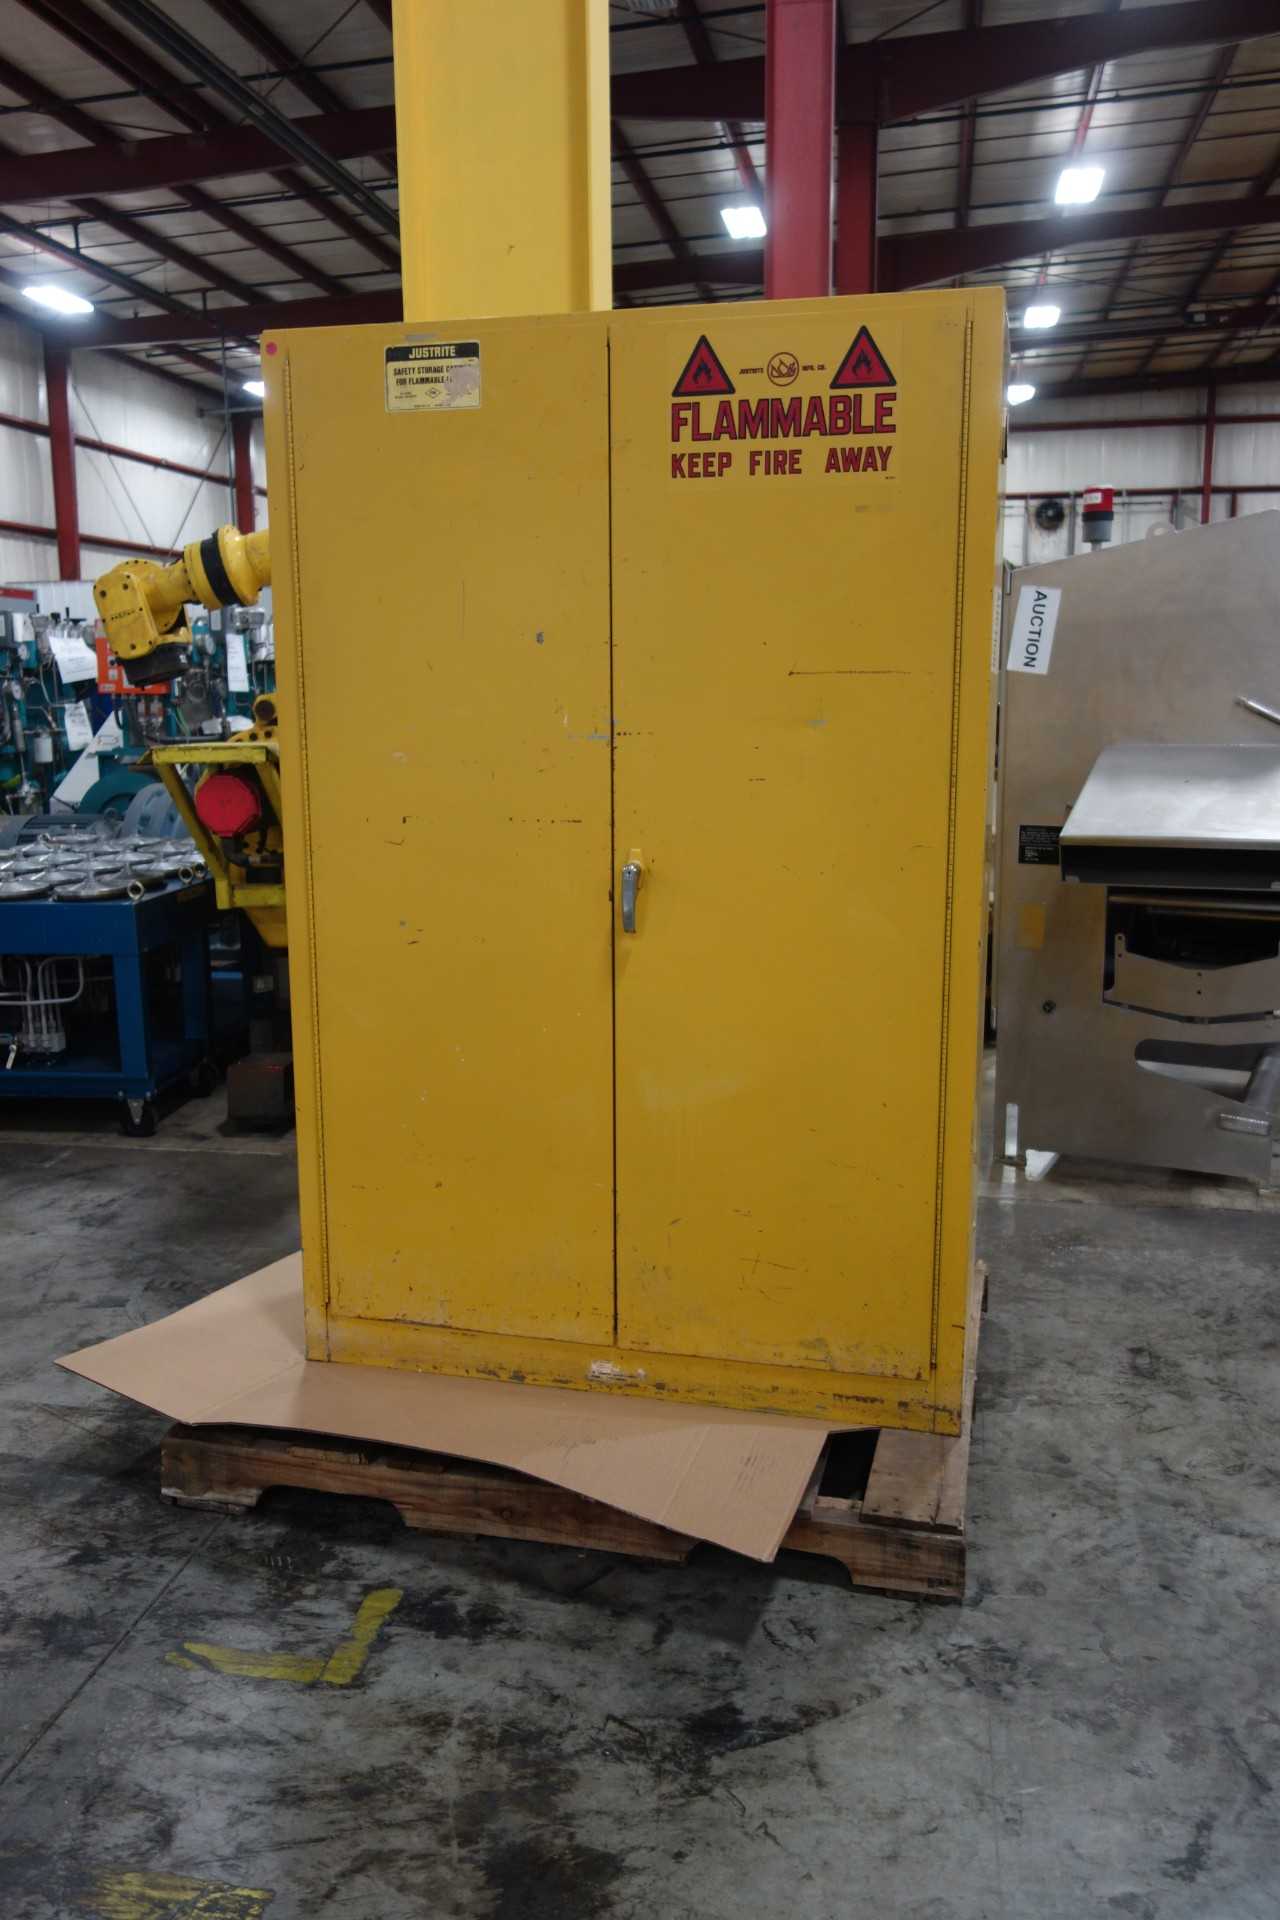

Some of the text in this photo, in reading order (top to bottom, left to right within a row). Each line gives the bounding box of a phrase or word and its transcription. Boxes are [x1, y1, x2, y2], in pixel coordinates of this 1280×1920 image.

[409, 345, 456, 359] JUSTRITE
[393, 367, 416, 376] SAFETY
[417, 365, 444, 375] STORAGE
[396, 378, 408, 386] FOR
[671, 392, 897, 442] FLAMMABLE
[671, 446, 893, 479] KEEP FIRE AWAY
[1023, 590, 1048, 668] AUCTION
